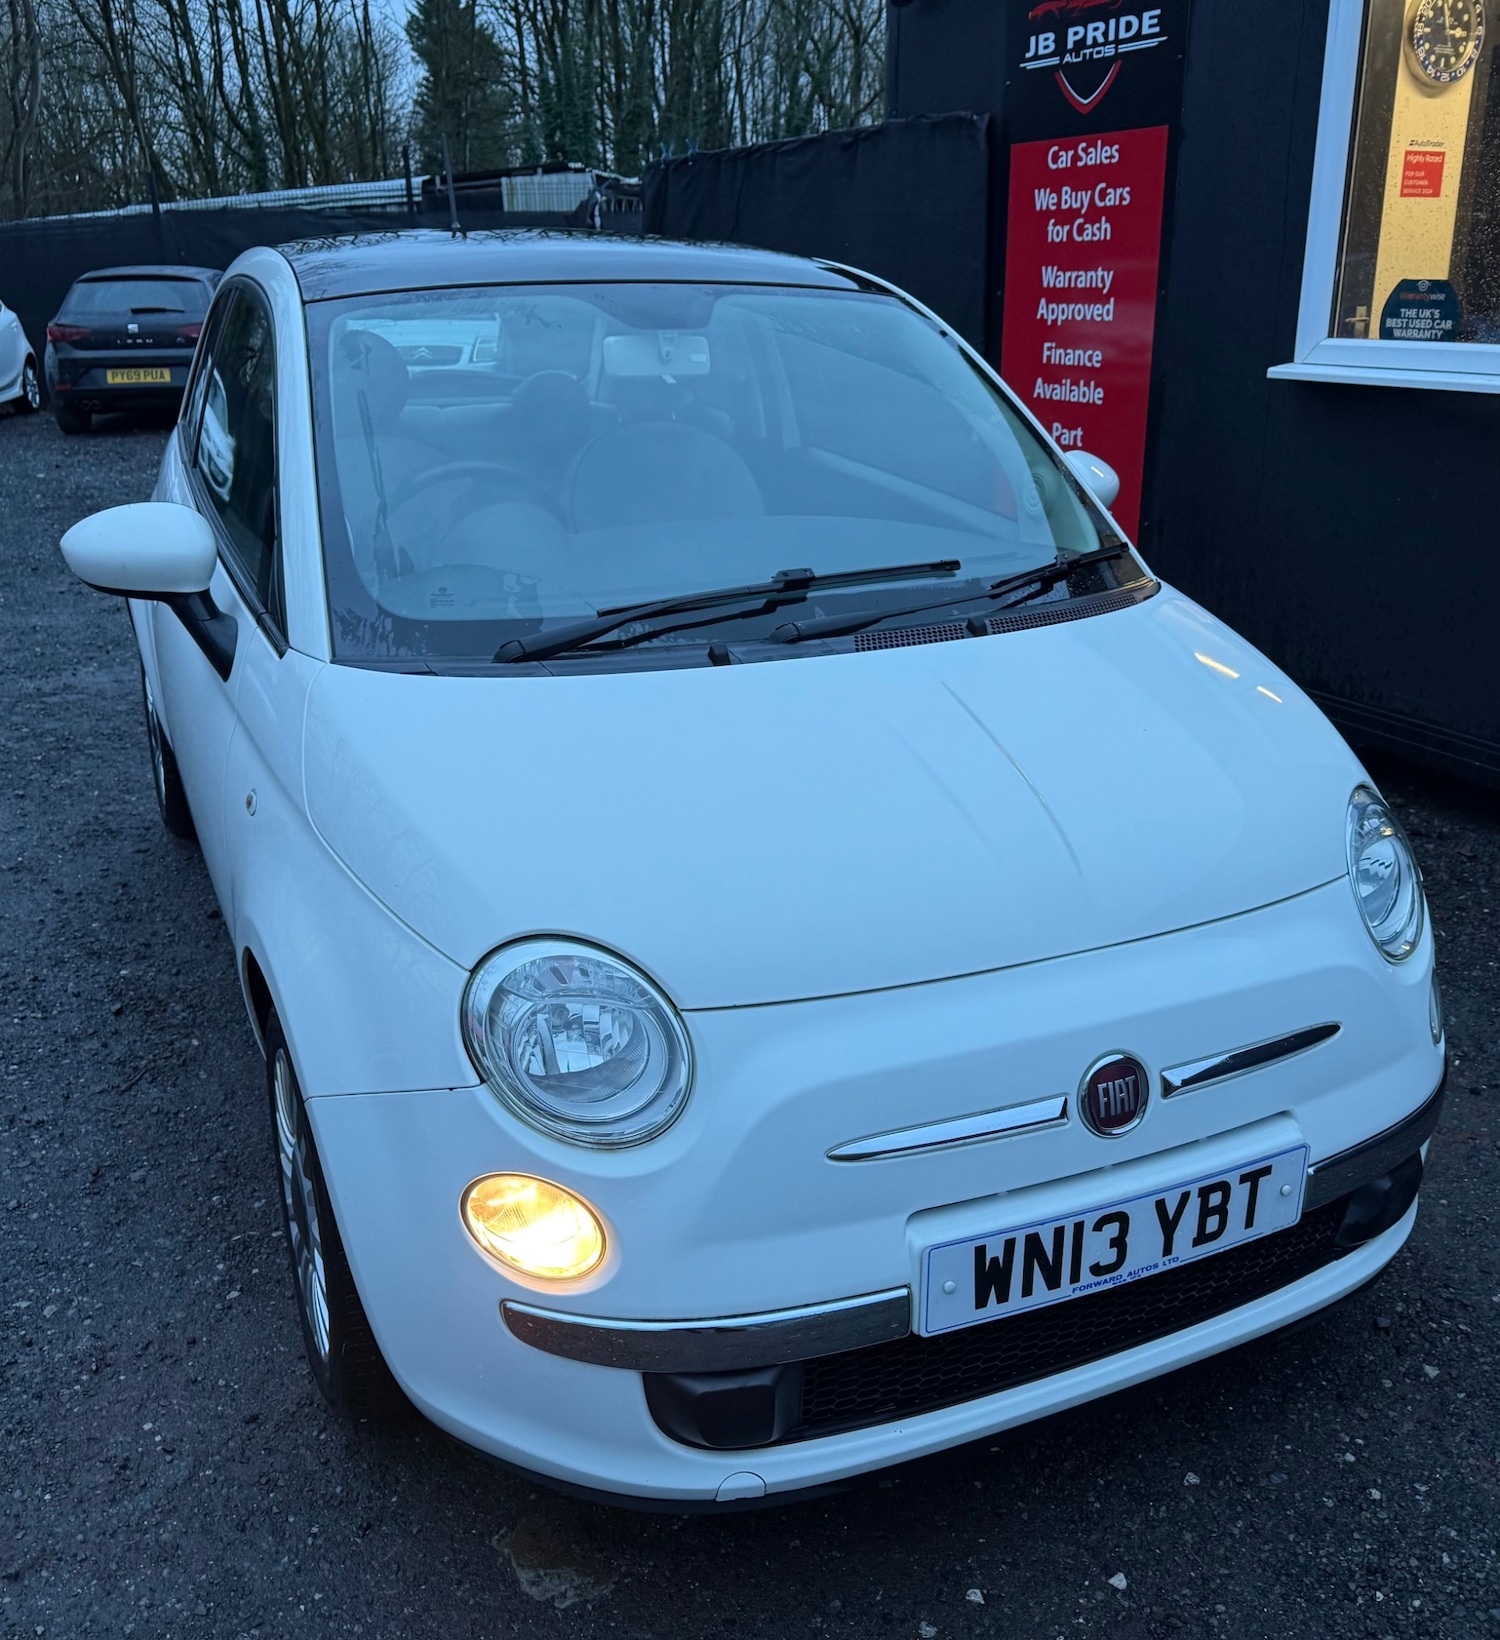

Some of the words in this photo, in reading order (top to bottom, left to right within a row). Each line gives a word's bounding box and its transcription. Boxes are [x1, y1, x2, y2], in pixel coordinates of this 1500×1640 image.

[1025, 32, 1056, 59] JB
[1067, 9, 1162, 50] PRIDE
[1062, 44, 1116, 65] AUTOS
[1047, 145, 1074, 169] Car
[1077, 139, 1120, 167] Sales
[1034, 188, 1058, 211] We
[1061, 186, 1091, 214] Buy
[1094, 183, 1131, 207] Cars
[1047, 218, 1070, 242] for
[1072, 216, 1111, 241] Cash
[1041, 265, 1114, 294] Warranty
[1036, 297, 1115, 326] Approved
[1385, 318, 1409, 328] BEST
[1408, 319, 1433, 328] USED
[1433, 320, 1453, 330] CAR
[1400, 308, 1418, 318] THE
[1419, 308, 1441, 318] UK'S
[1393, 328, 1444, 339] WARRANTY
[1042, 342, 1103, 367] Finance
[111, 369, 141, 382] PY69
[143, 369, 166, 381] PUA
[1033, 377, 1104, 405] Available
[1052, 422, 1083, 447] Part
[1097, 1075, 1136, 1119] FIAT
[973, 1210, 1130, 1311] WN13
[1154, 1164, 1273, 1258] YBT
[1071, 1274, 1123, 1294] FORWARD
[1126, 1262, 1160, 1278] AUTOS
[1162, 1256, 1180, 1267] LTD
